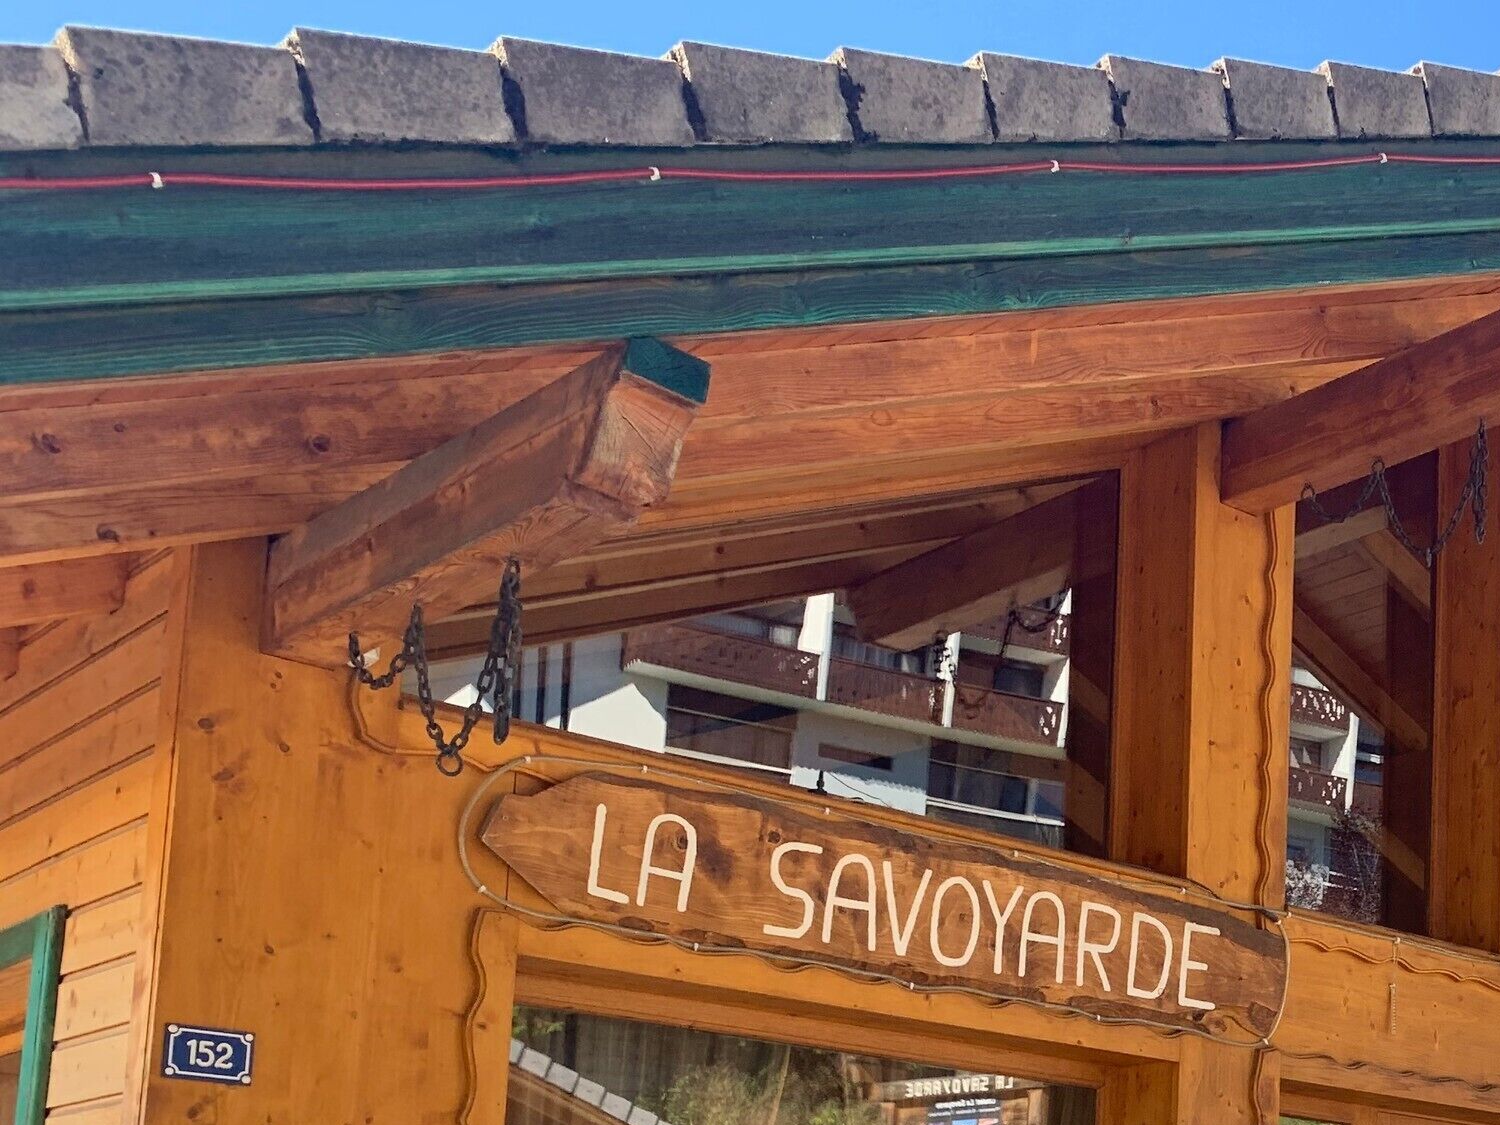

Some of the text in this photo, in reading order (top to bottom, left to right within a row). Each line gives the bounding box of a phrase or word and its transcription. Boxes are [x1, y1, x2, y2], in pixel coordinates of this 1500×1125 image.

[588, 803, 1221, 1011] LA SAVOYARDE
[187, 1039, 234, 1069] 152
